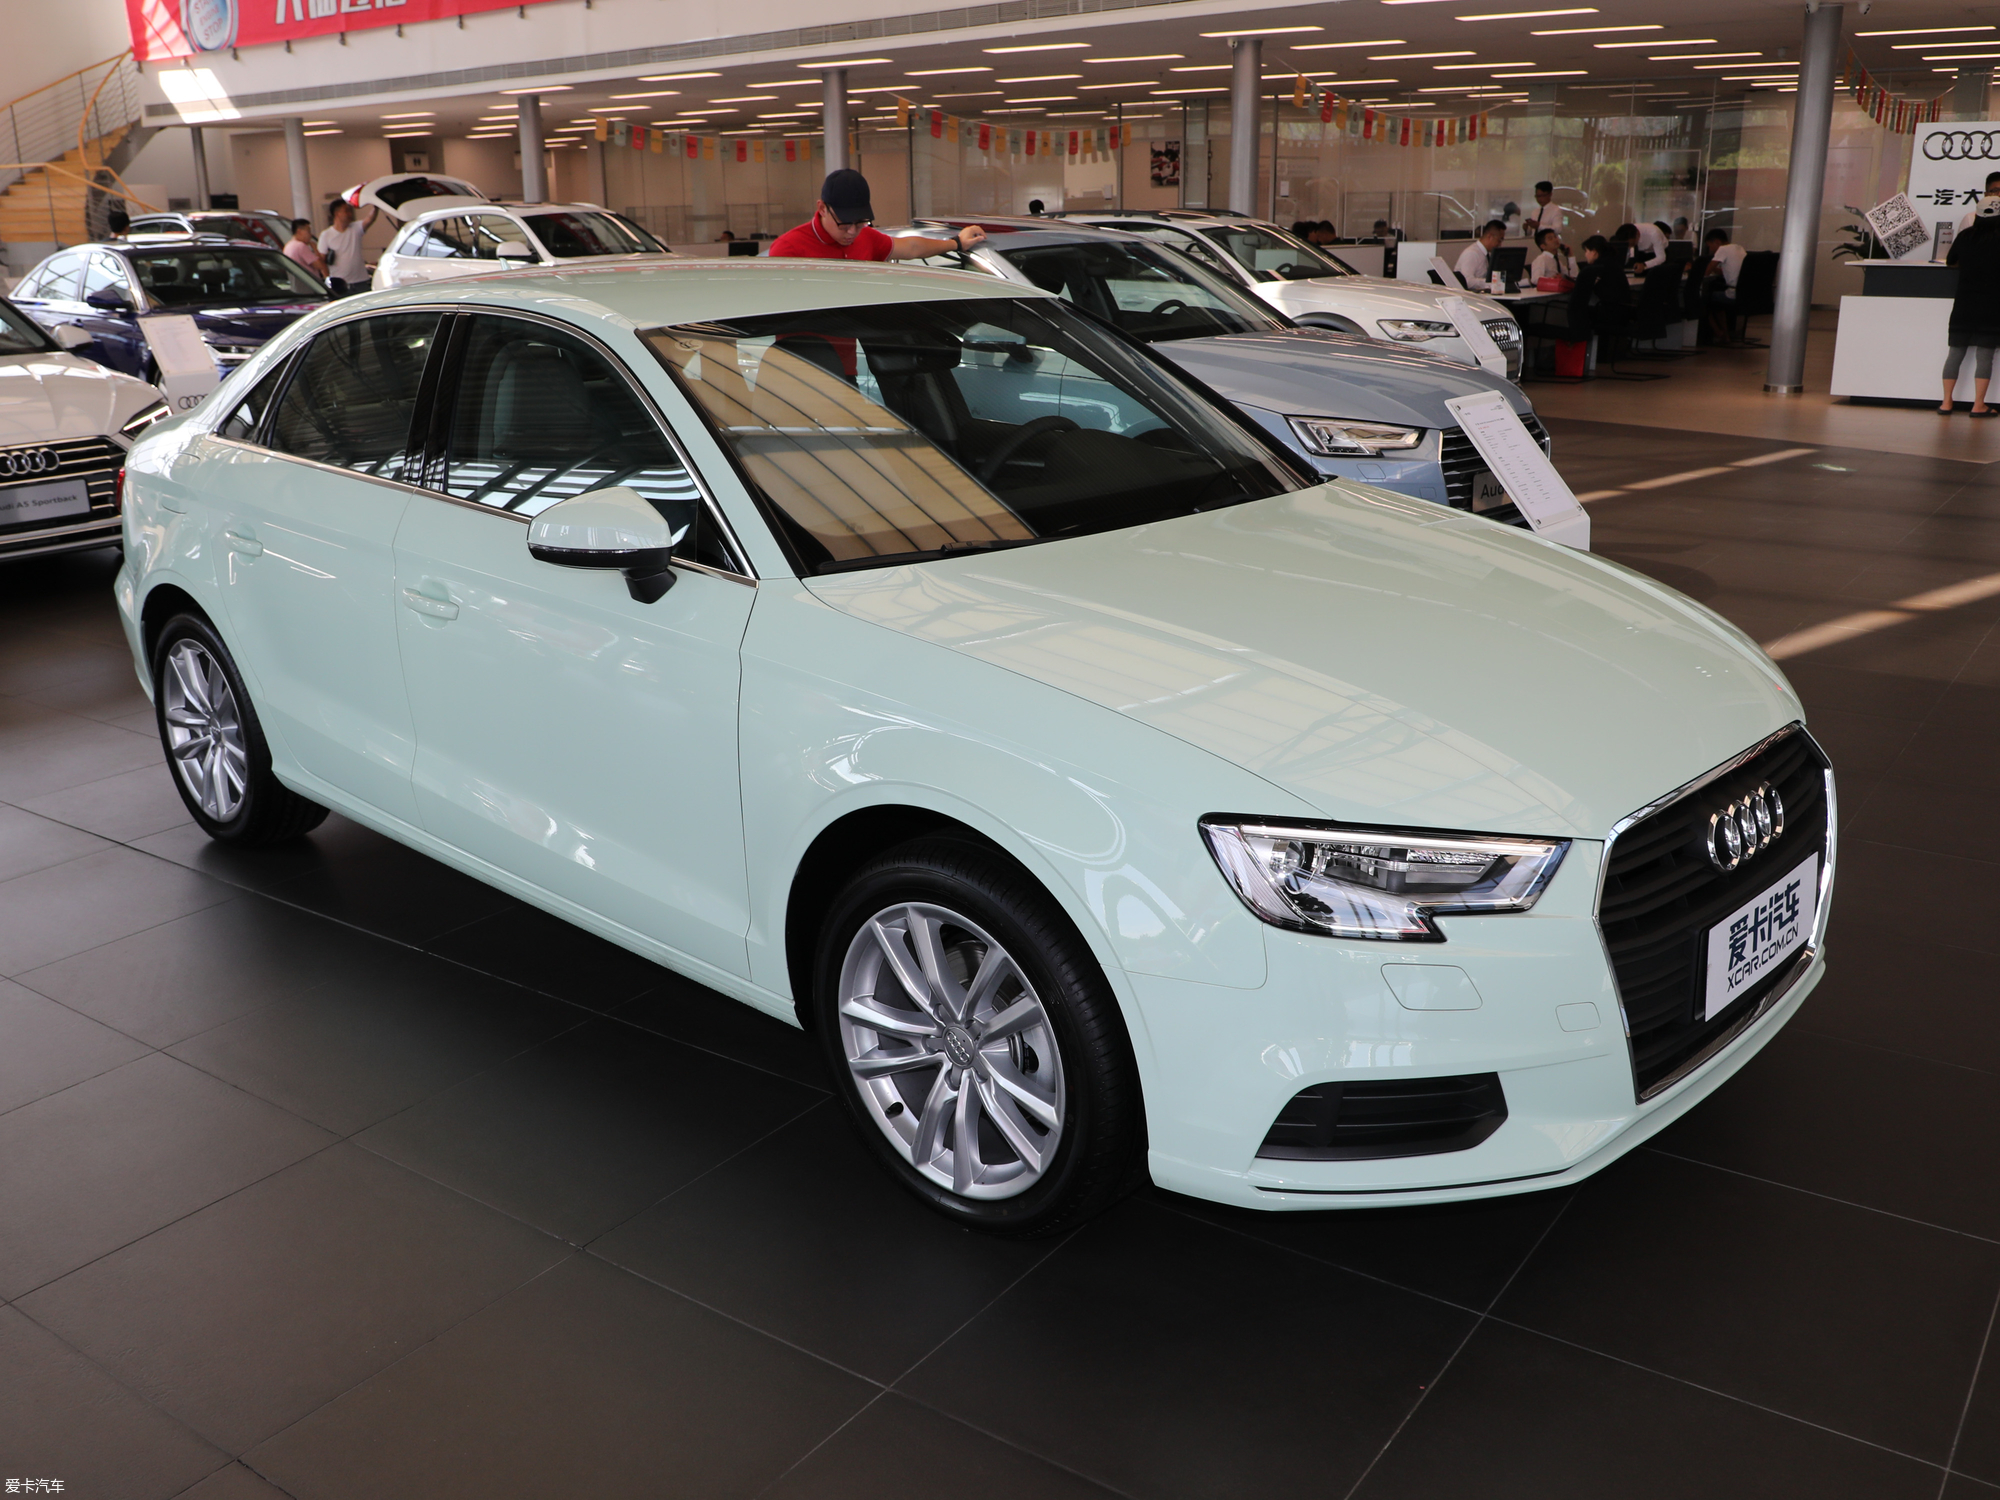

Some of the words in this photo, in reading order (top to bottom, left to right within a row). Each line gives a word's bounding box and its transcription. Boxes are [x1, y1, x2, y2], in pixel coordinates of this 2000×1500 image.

[204, 18, 223, 40] STOP
[32, 495, 77, 506] Sportback
[1727, 879, 1801, 972] 爱卡汽车
[1727, 922, 1799, 992] XCAR.COM.CN
